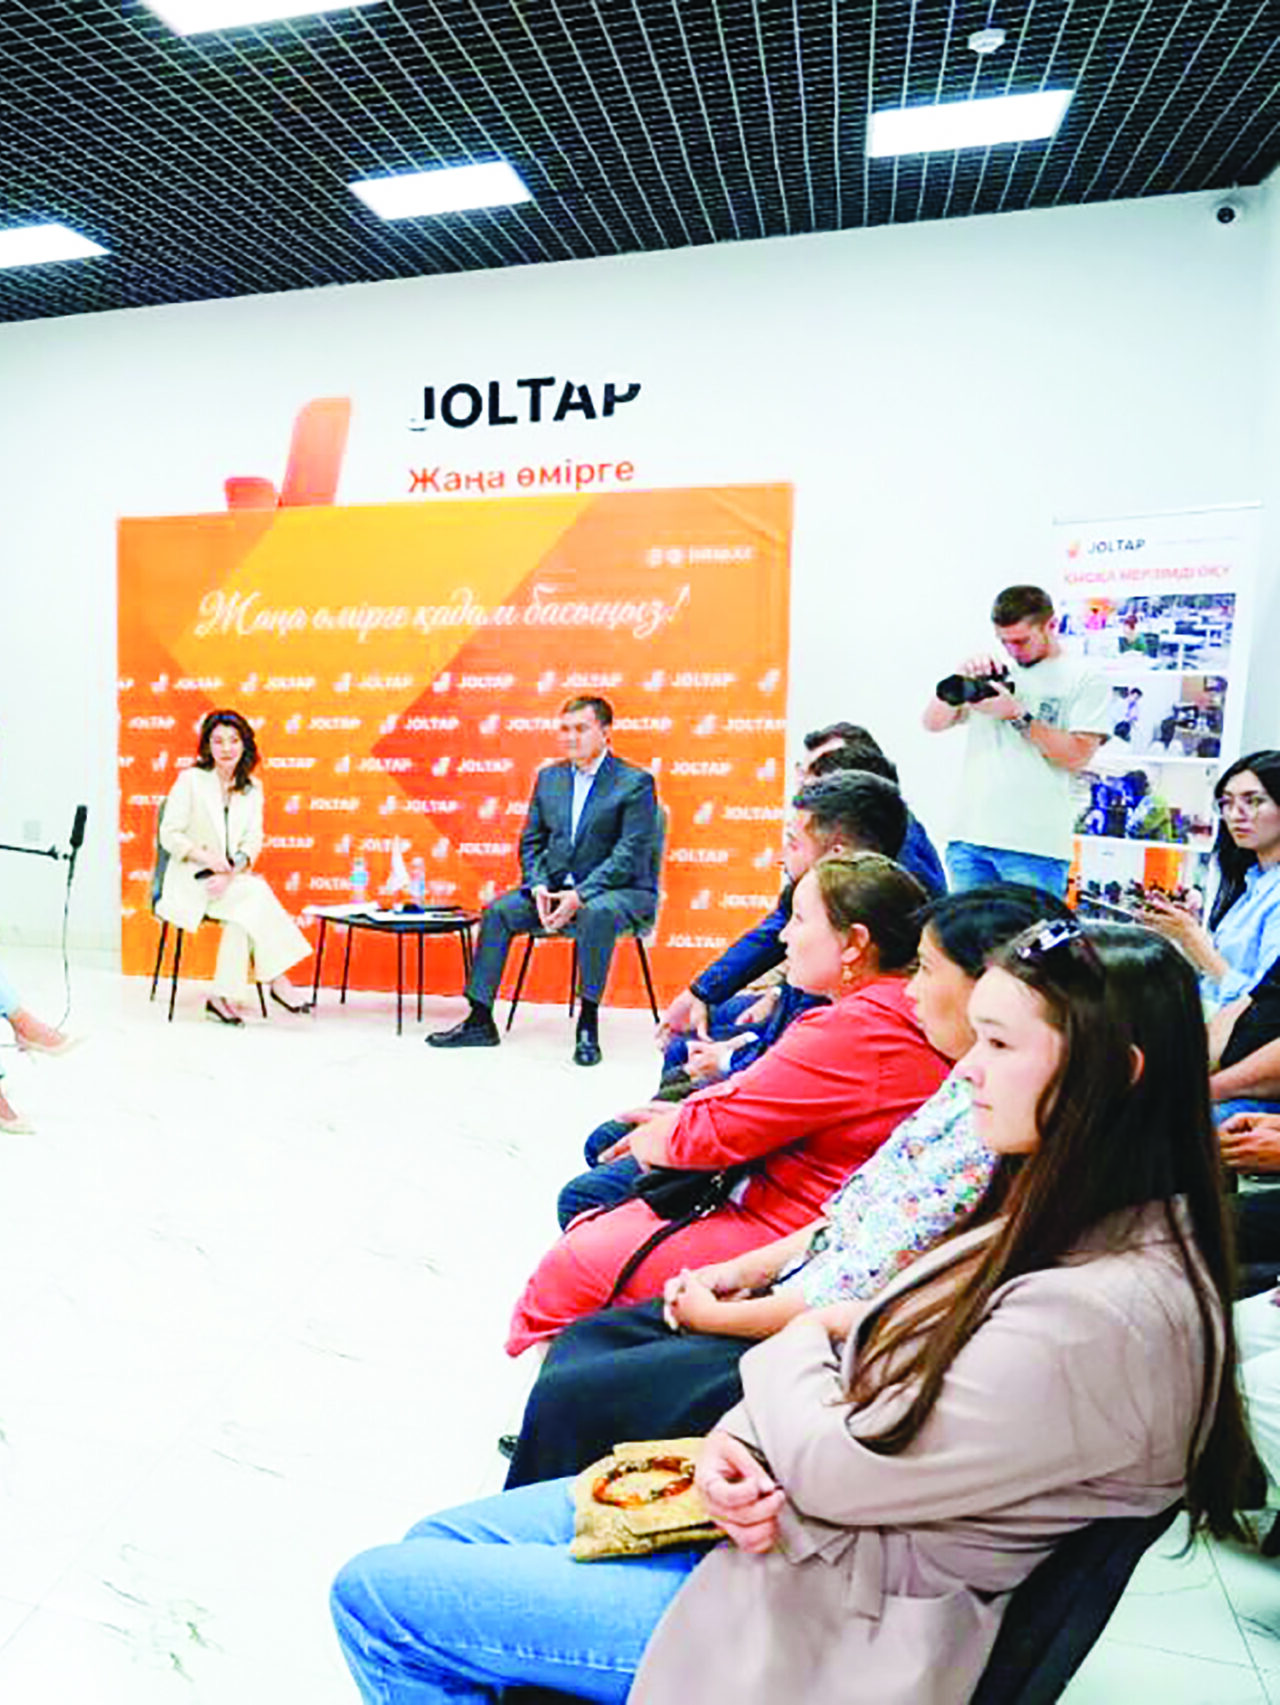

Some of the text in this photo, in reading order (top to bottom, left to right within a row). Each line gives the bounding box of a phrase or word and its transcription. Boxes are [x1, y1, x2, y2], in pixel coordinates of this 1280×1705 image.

[408, 459, 635, 493] Жаңа өмірге
[1088, 538, 1145, 554] JOLTAP
